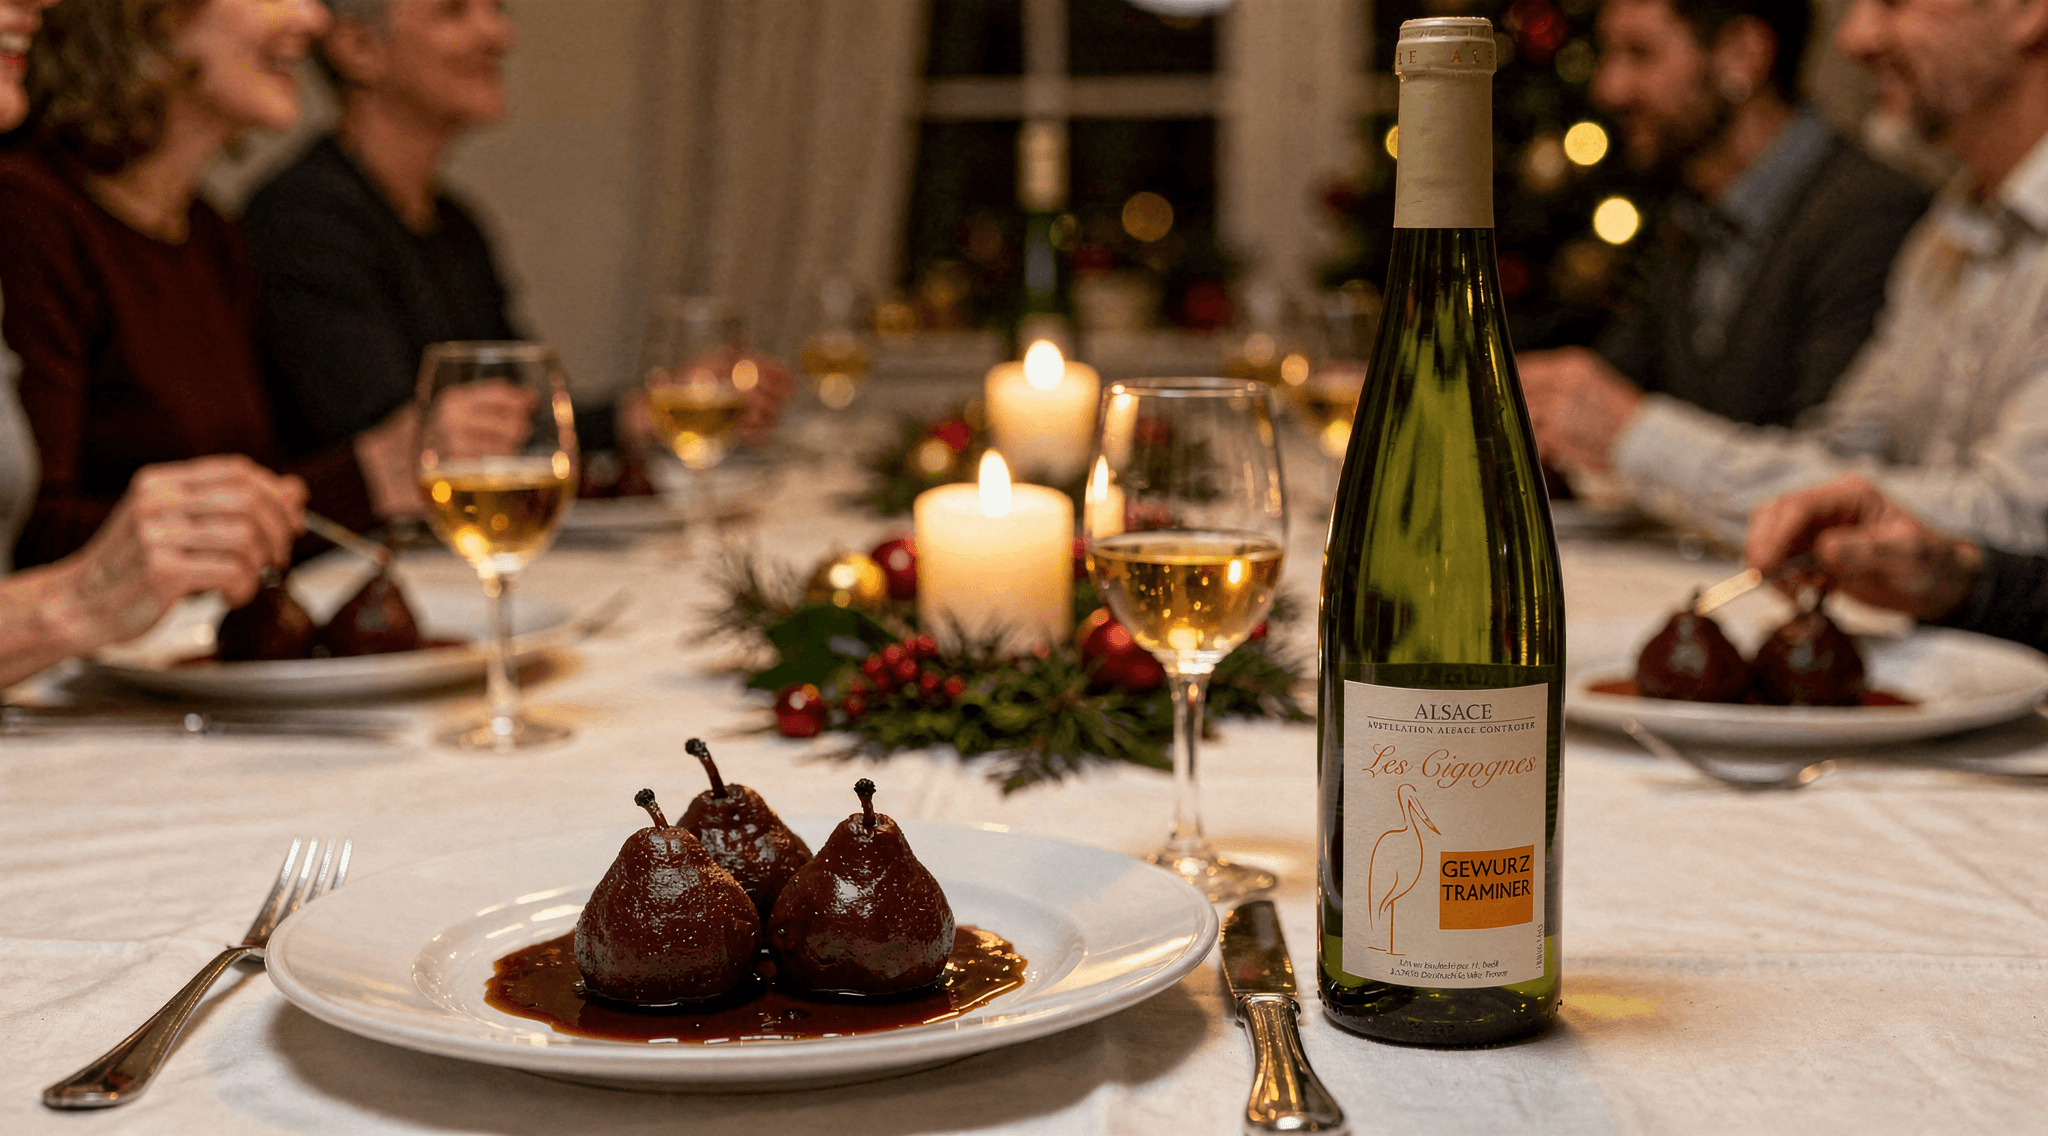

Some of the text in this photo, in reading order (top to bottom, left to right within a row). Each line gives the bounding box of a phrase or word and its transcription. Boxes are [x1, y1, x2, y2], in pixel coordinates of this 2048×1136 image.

[1414, 703, 1493, 720] ALSACE
[1362, 743, 1537, 789] Les Cigognes
[1442, 854, 1531, 878] GEWURZ
[1441, 879, 1531, 901] TRAMINER
